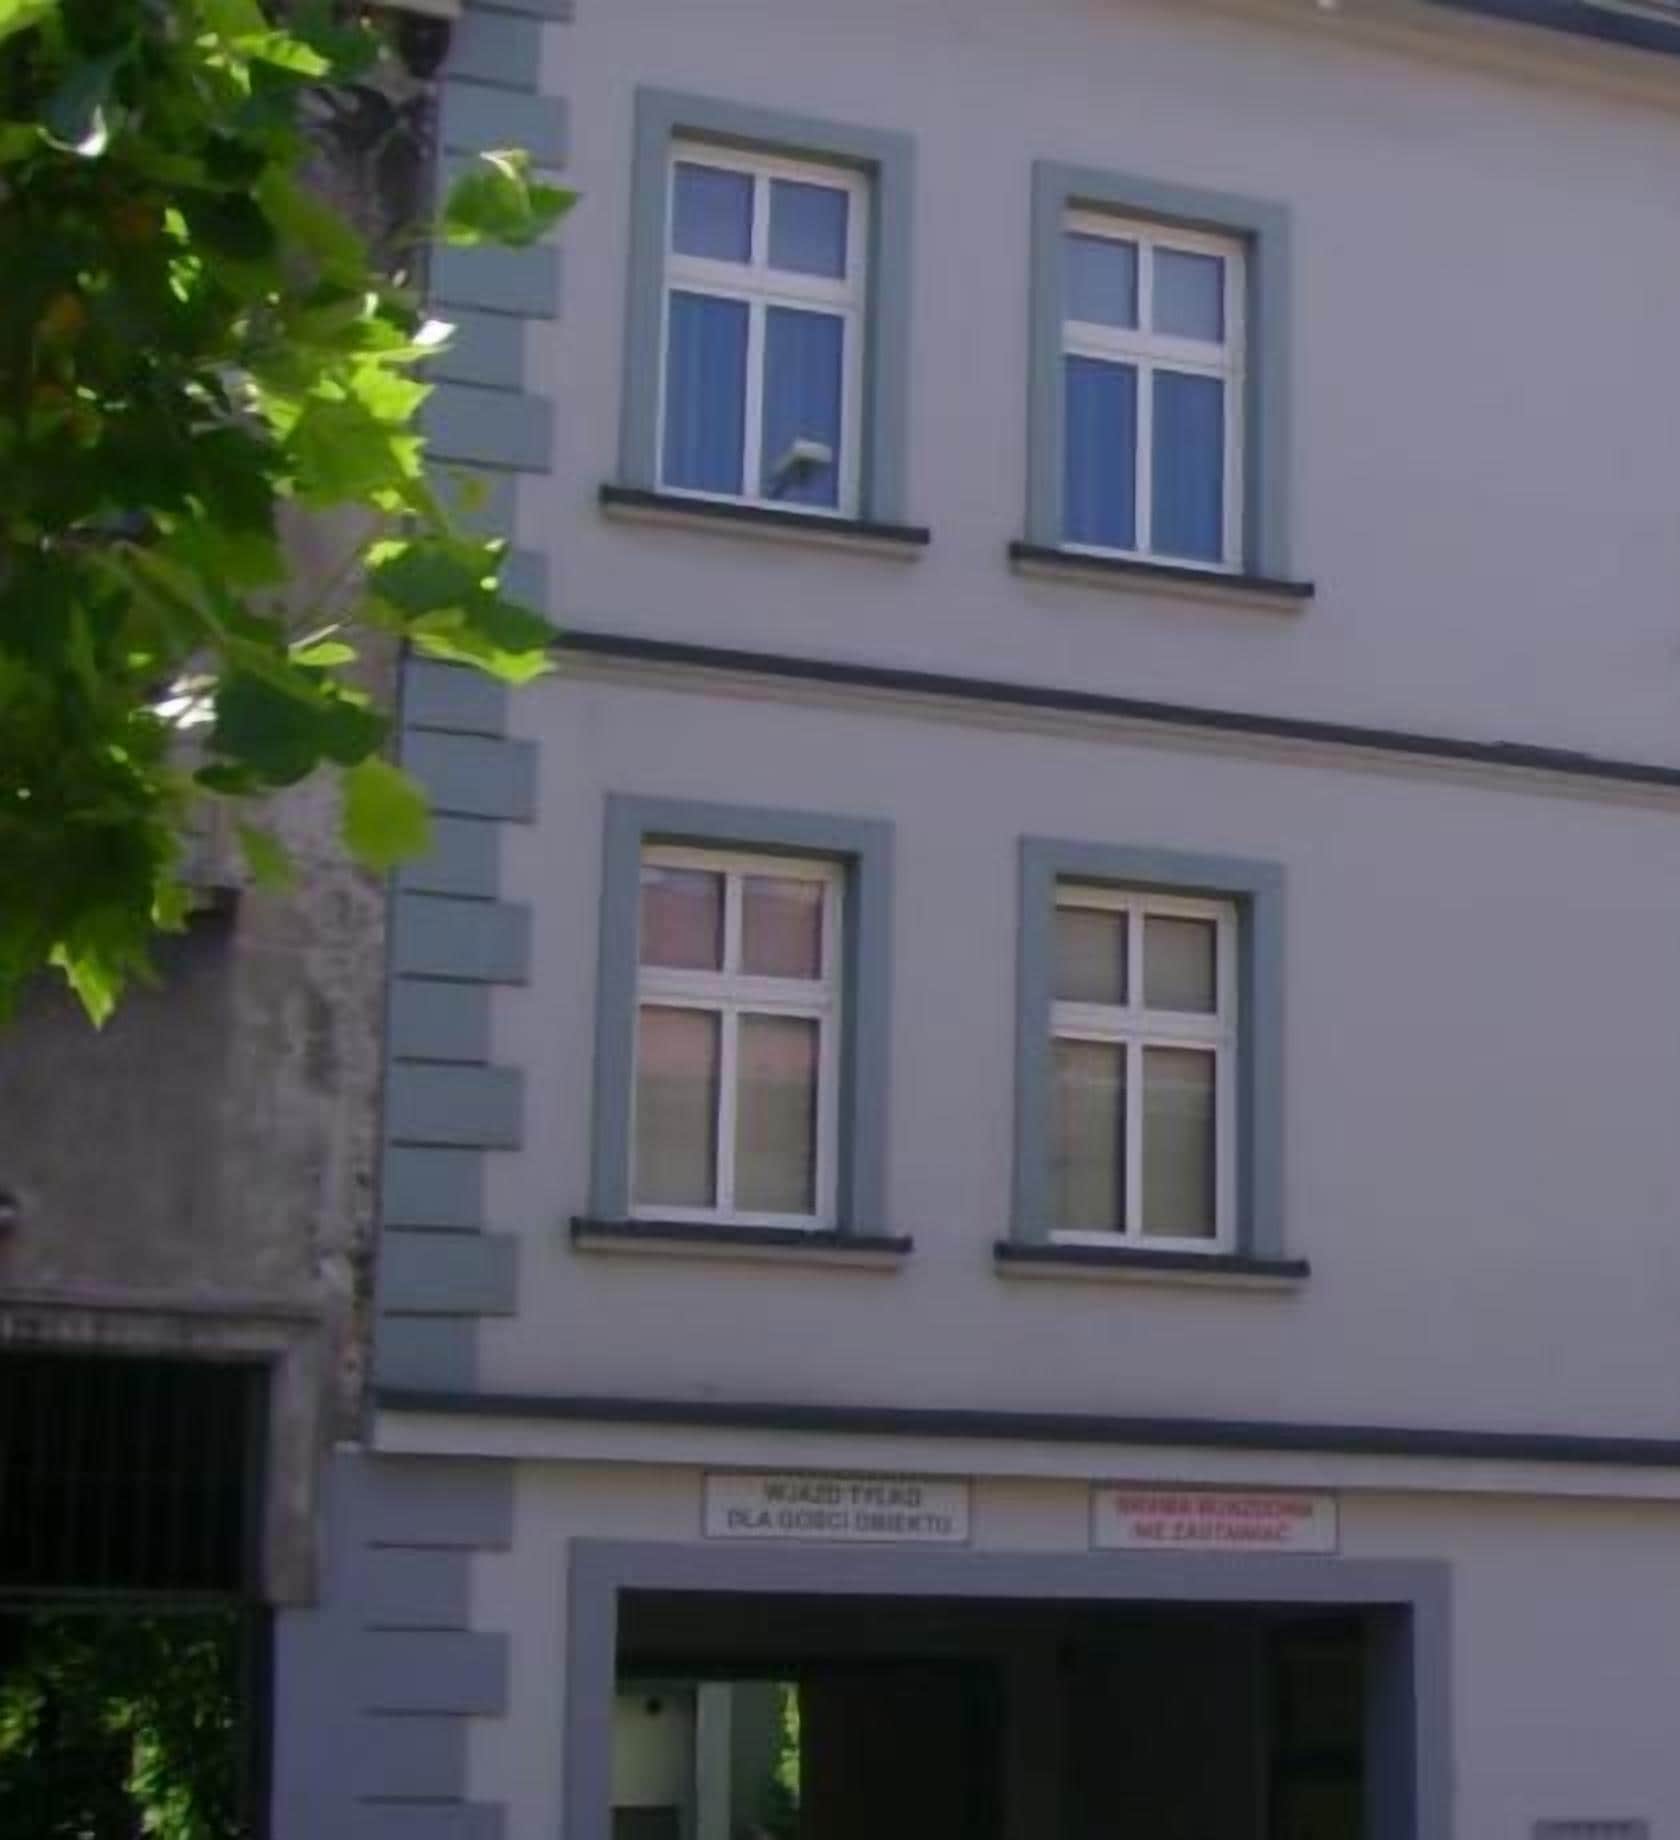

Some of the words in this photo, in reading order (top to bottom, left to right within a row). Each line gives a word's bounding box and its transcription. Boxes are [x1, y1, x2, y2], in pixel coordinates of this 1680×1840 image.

[766, 1483, 841, 1504] WJAZD
[850, 1485, 921, 1507] TYLKO
[727, 1510, 771, 1529] DLA
